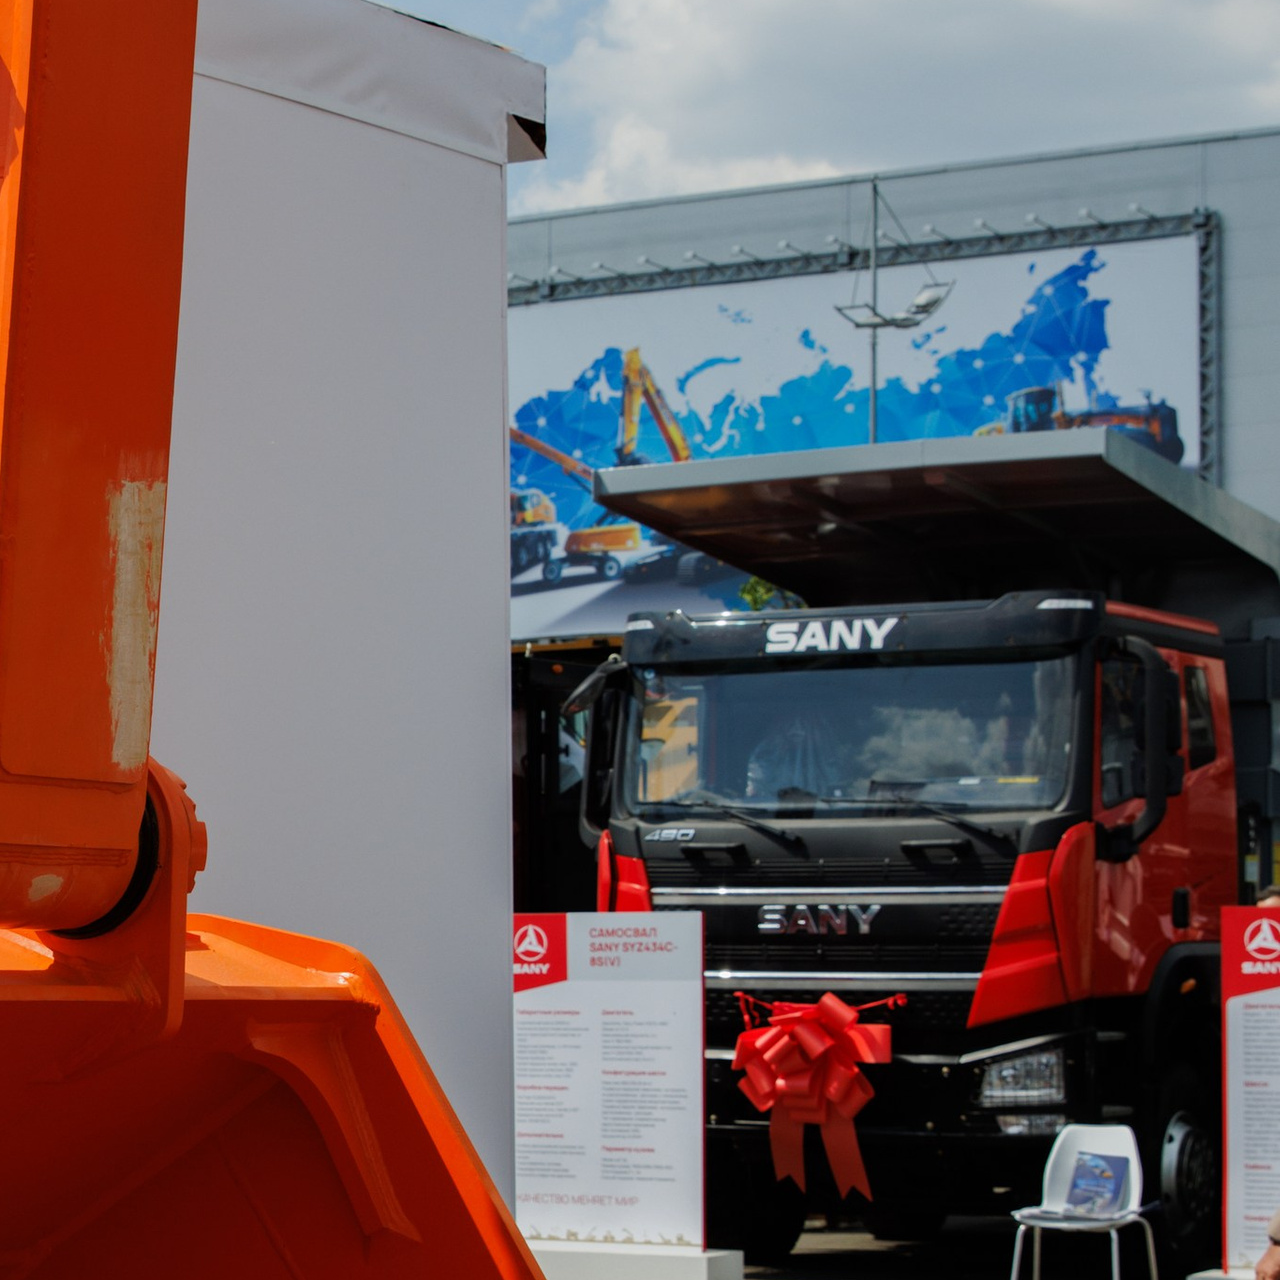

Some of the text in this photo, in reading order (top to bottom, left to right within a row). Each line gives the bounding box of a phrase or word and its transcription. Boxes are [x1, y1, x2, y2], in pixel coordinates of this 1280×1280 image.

[765, 617, 899, 653] SANY
[644, 828, 696, 841] 490
[758, 904, 882, 935] SANY
[589, 927, 658, 938] САМОСВАЛ
[589, 942, 619, 953] SANY
[513, 963, 550, 975] SANY
[1241, 961, 1280, 974] SAN
